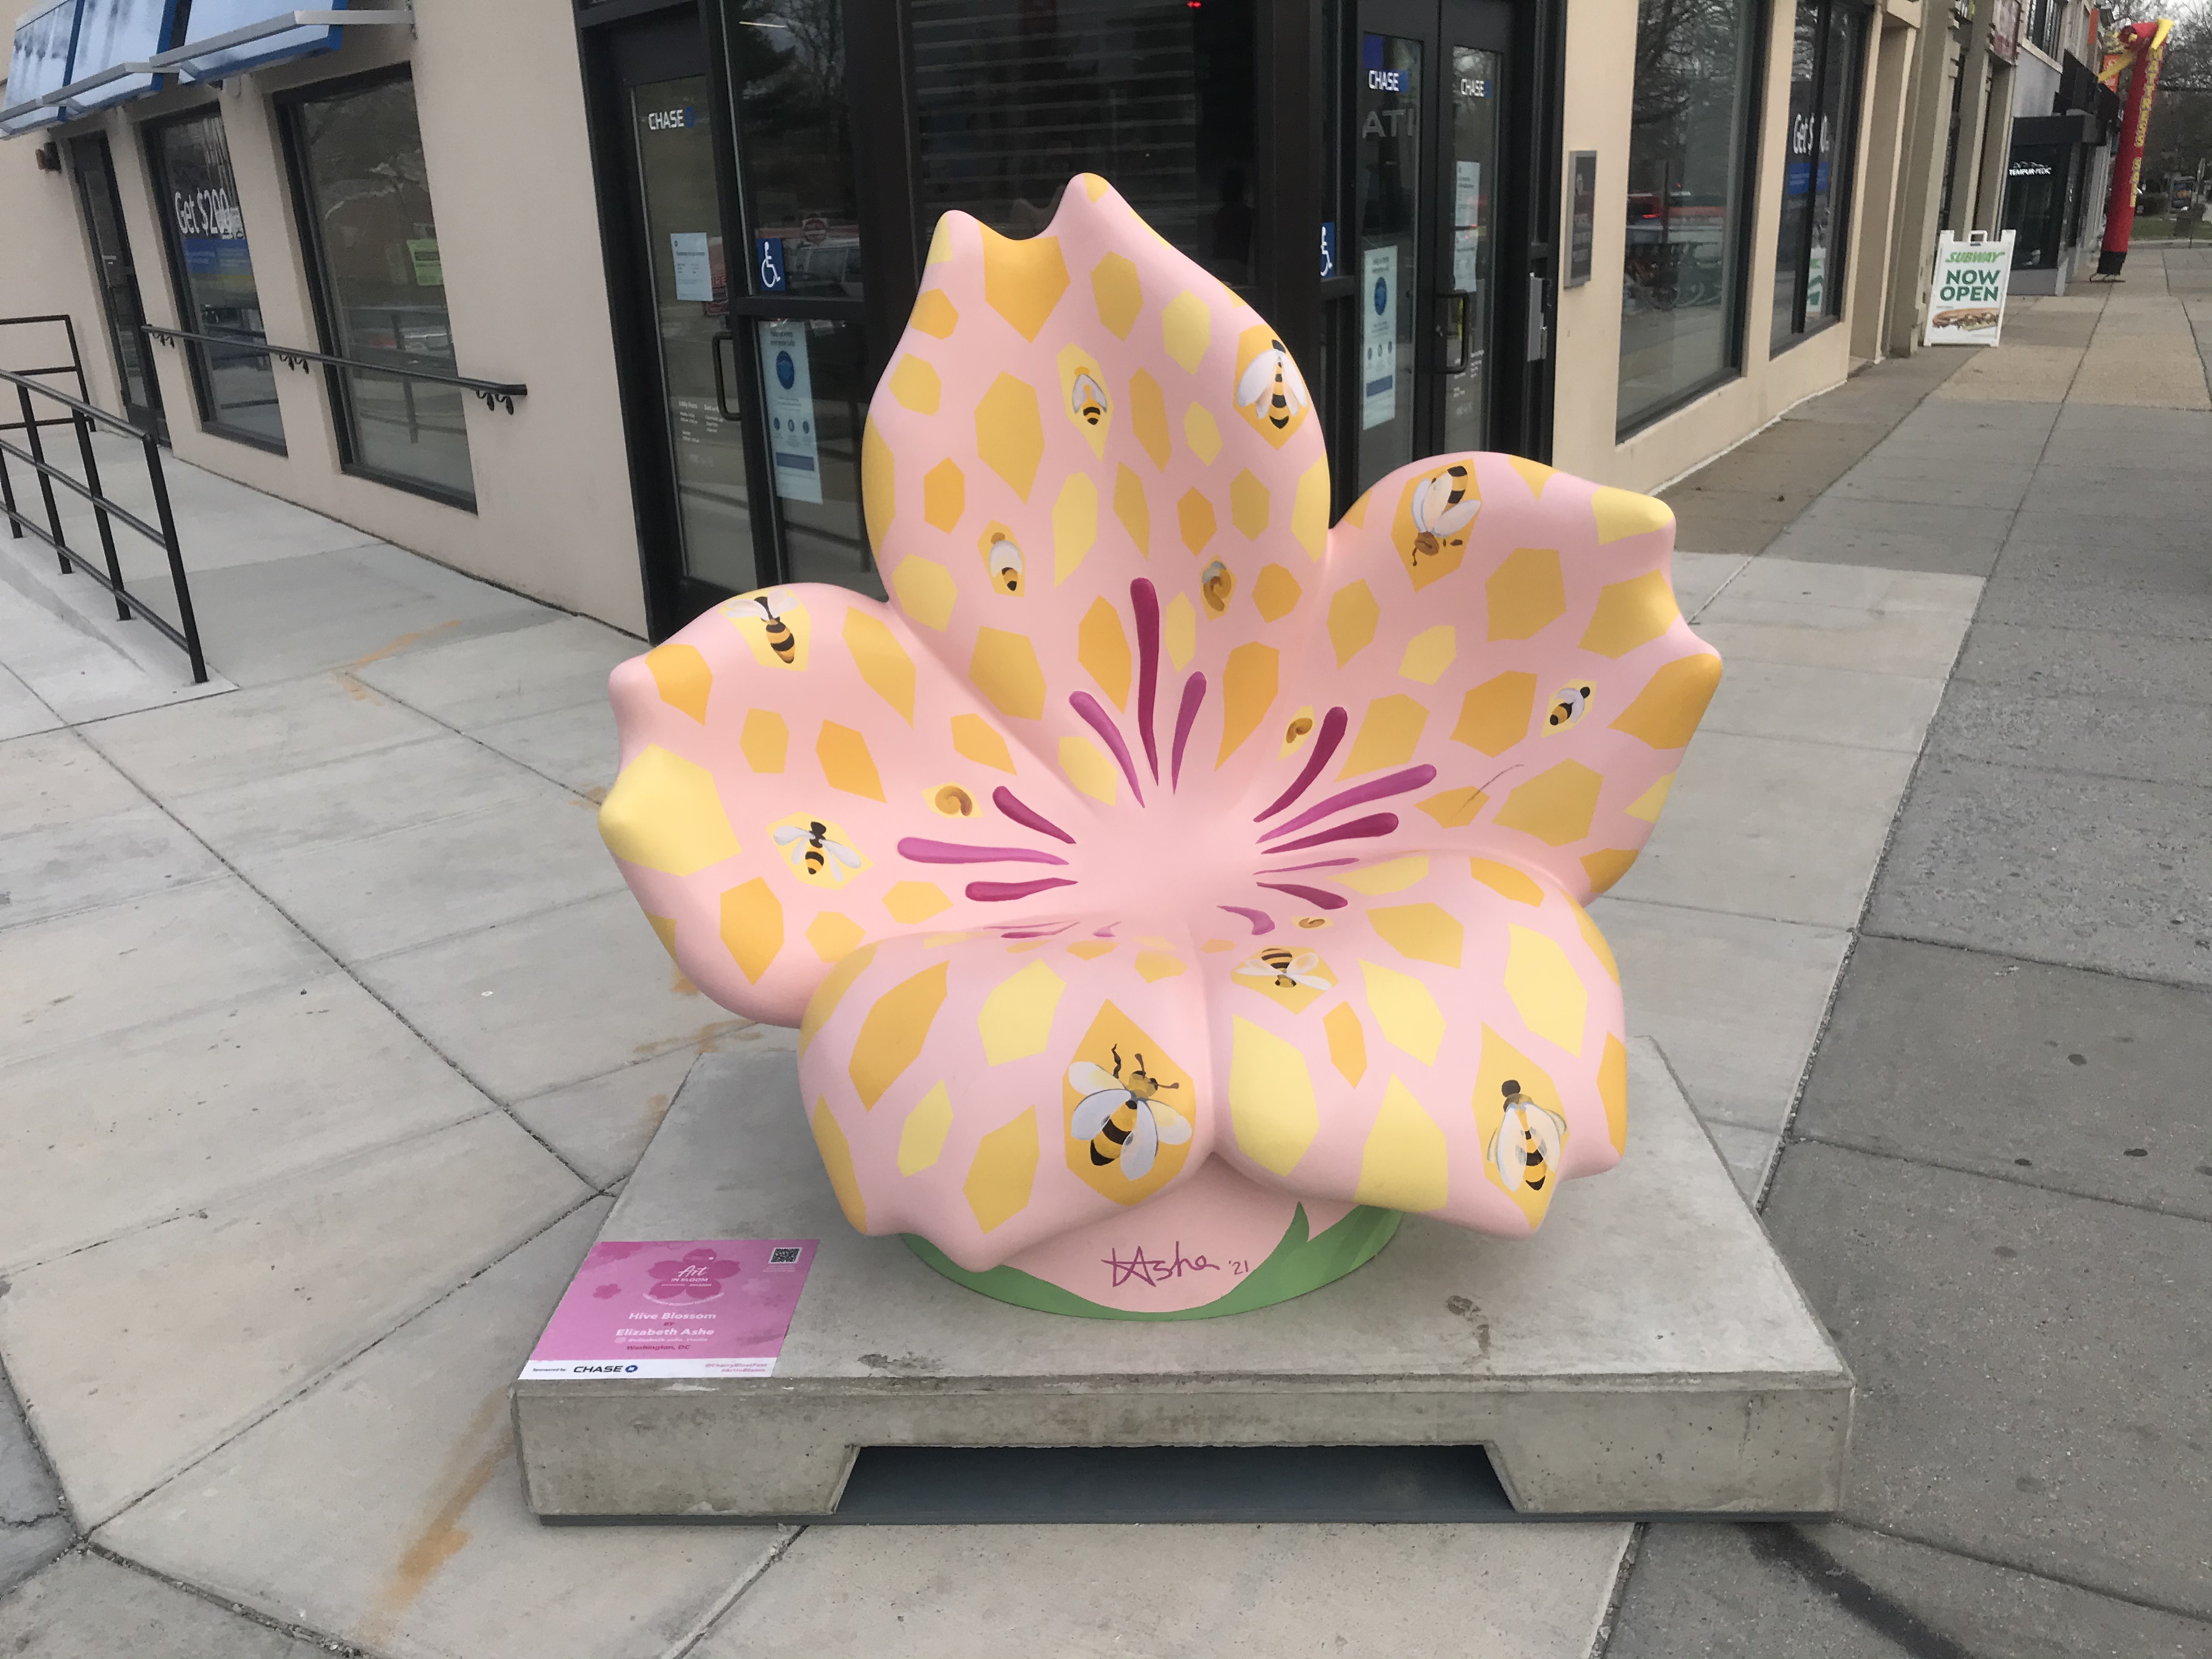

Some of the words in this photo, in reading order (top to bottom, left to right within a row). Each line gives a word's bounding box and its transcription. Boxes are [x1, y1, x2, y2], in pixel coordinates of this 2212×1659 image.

[1369, 70, 1399, 92] CHASE
[1461, 78, 1485, 97] CHASE
[2134, 46, 2164, 147] MATTRESS
[648, 109, 684, 130] CHASE
[1793, 113, 1808, 154] Get
[2130, 157, 2142, 207] SALE
[175, 191, 200, 234] Get
[1945, 252, 2005, 263] SUBWAY
[1946, 269, 2001, 285] NOW
[1940, 286, 1998, 301] OPEN
[678, 1265, 709, 1277] Art
